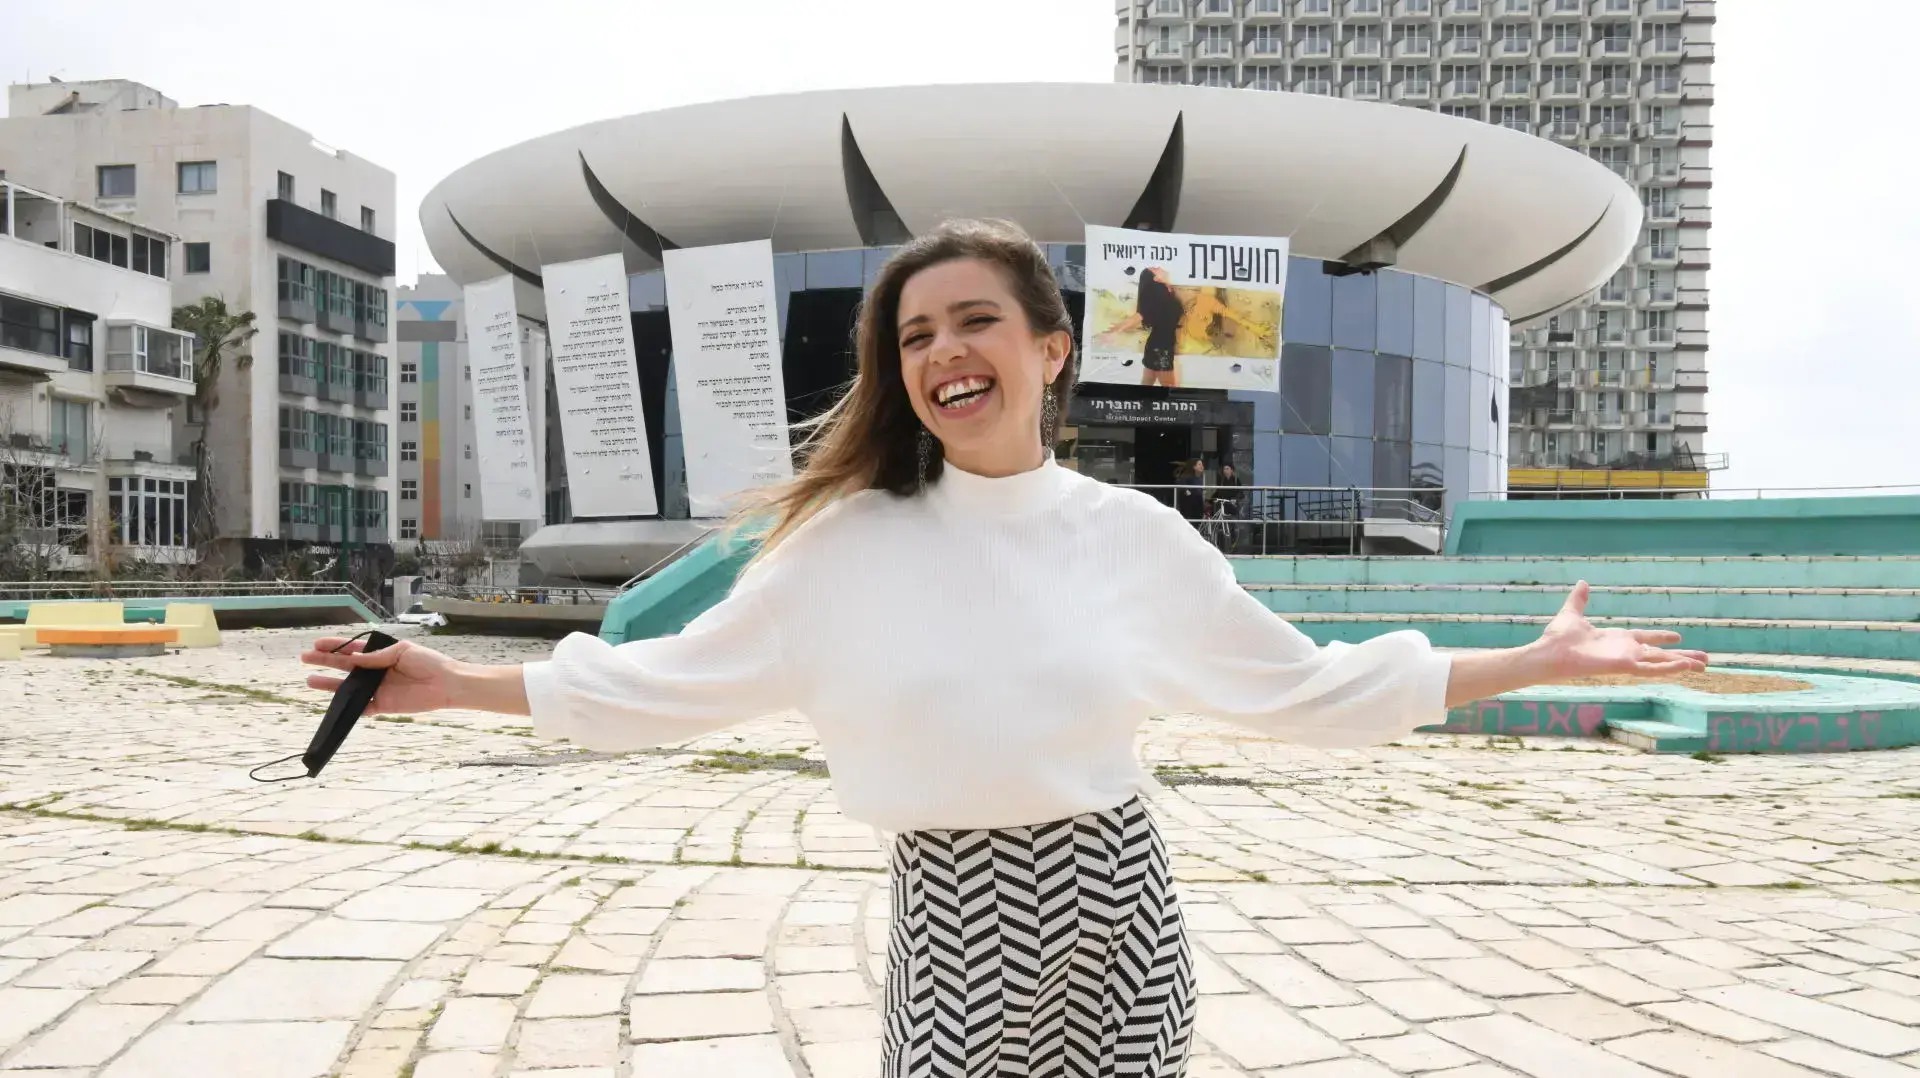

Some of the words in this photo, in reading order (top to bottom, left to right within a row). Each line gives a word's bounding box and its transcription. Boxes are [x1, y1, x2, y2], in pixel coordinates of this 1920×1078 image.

[1151, 245, 1178, 261] ילנה
[1188, 242, 1280, 285] חושפת
[1091, 400, 1141, 410] החברתי
[1152, 401, 1197, 411] המרחב
[308, 545, 330, 555] ROWN
